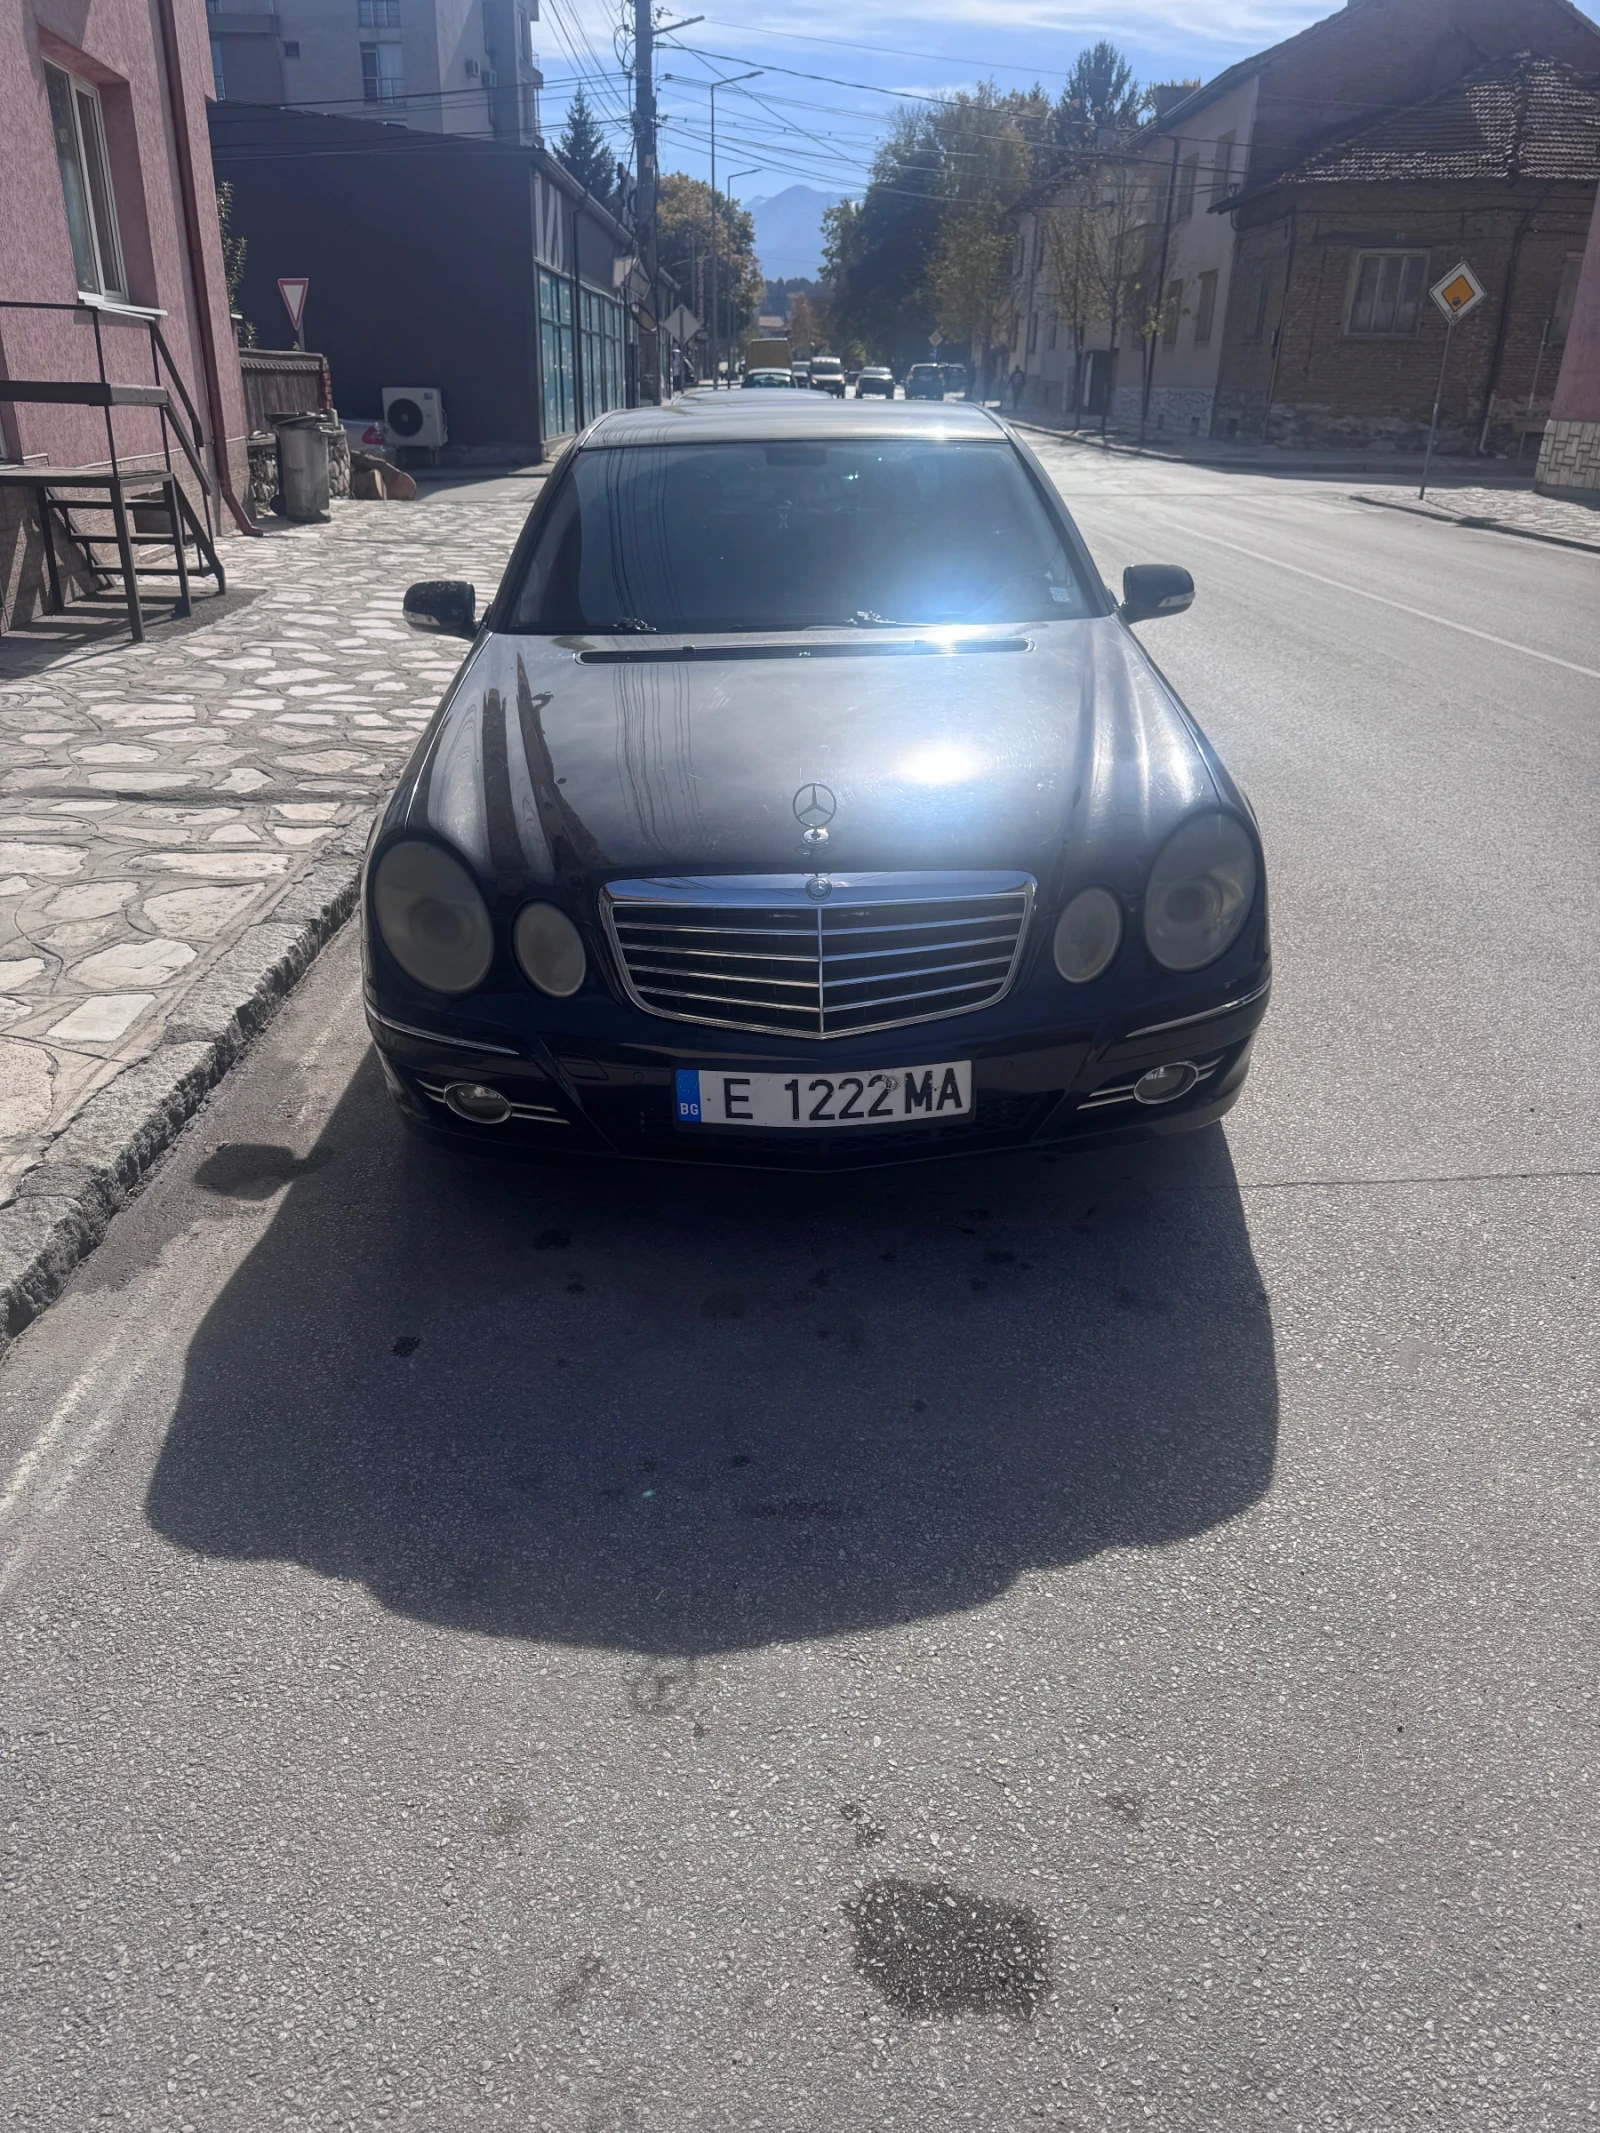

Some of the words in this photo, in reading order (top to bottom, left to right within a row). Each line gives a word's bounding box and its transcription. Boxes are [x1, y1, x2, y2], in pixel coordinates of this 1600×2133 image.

[680, 1103, 699, 1115] BG
[723, 1078, 753, 1119] E
[784, 1074, 893, 1121] 1222
[904, 1068, 963, 1114] MA
